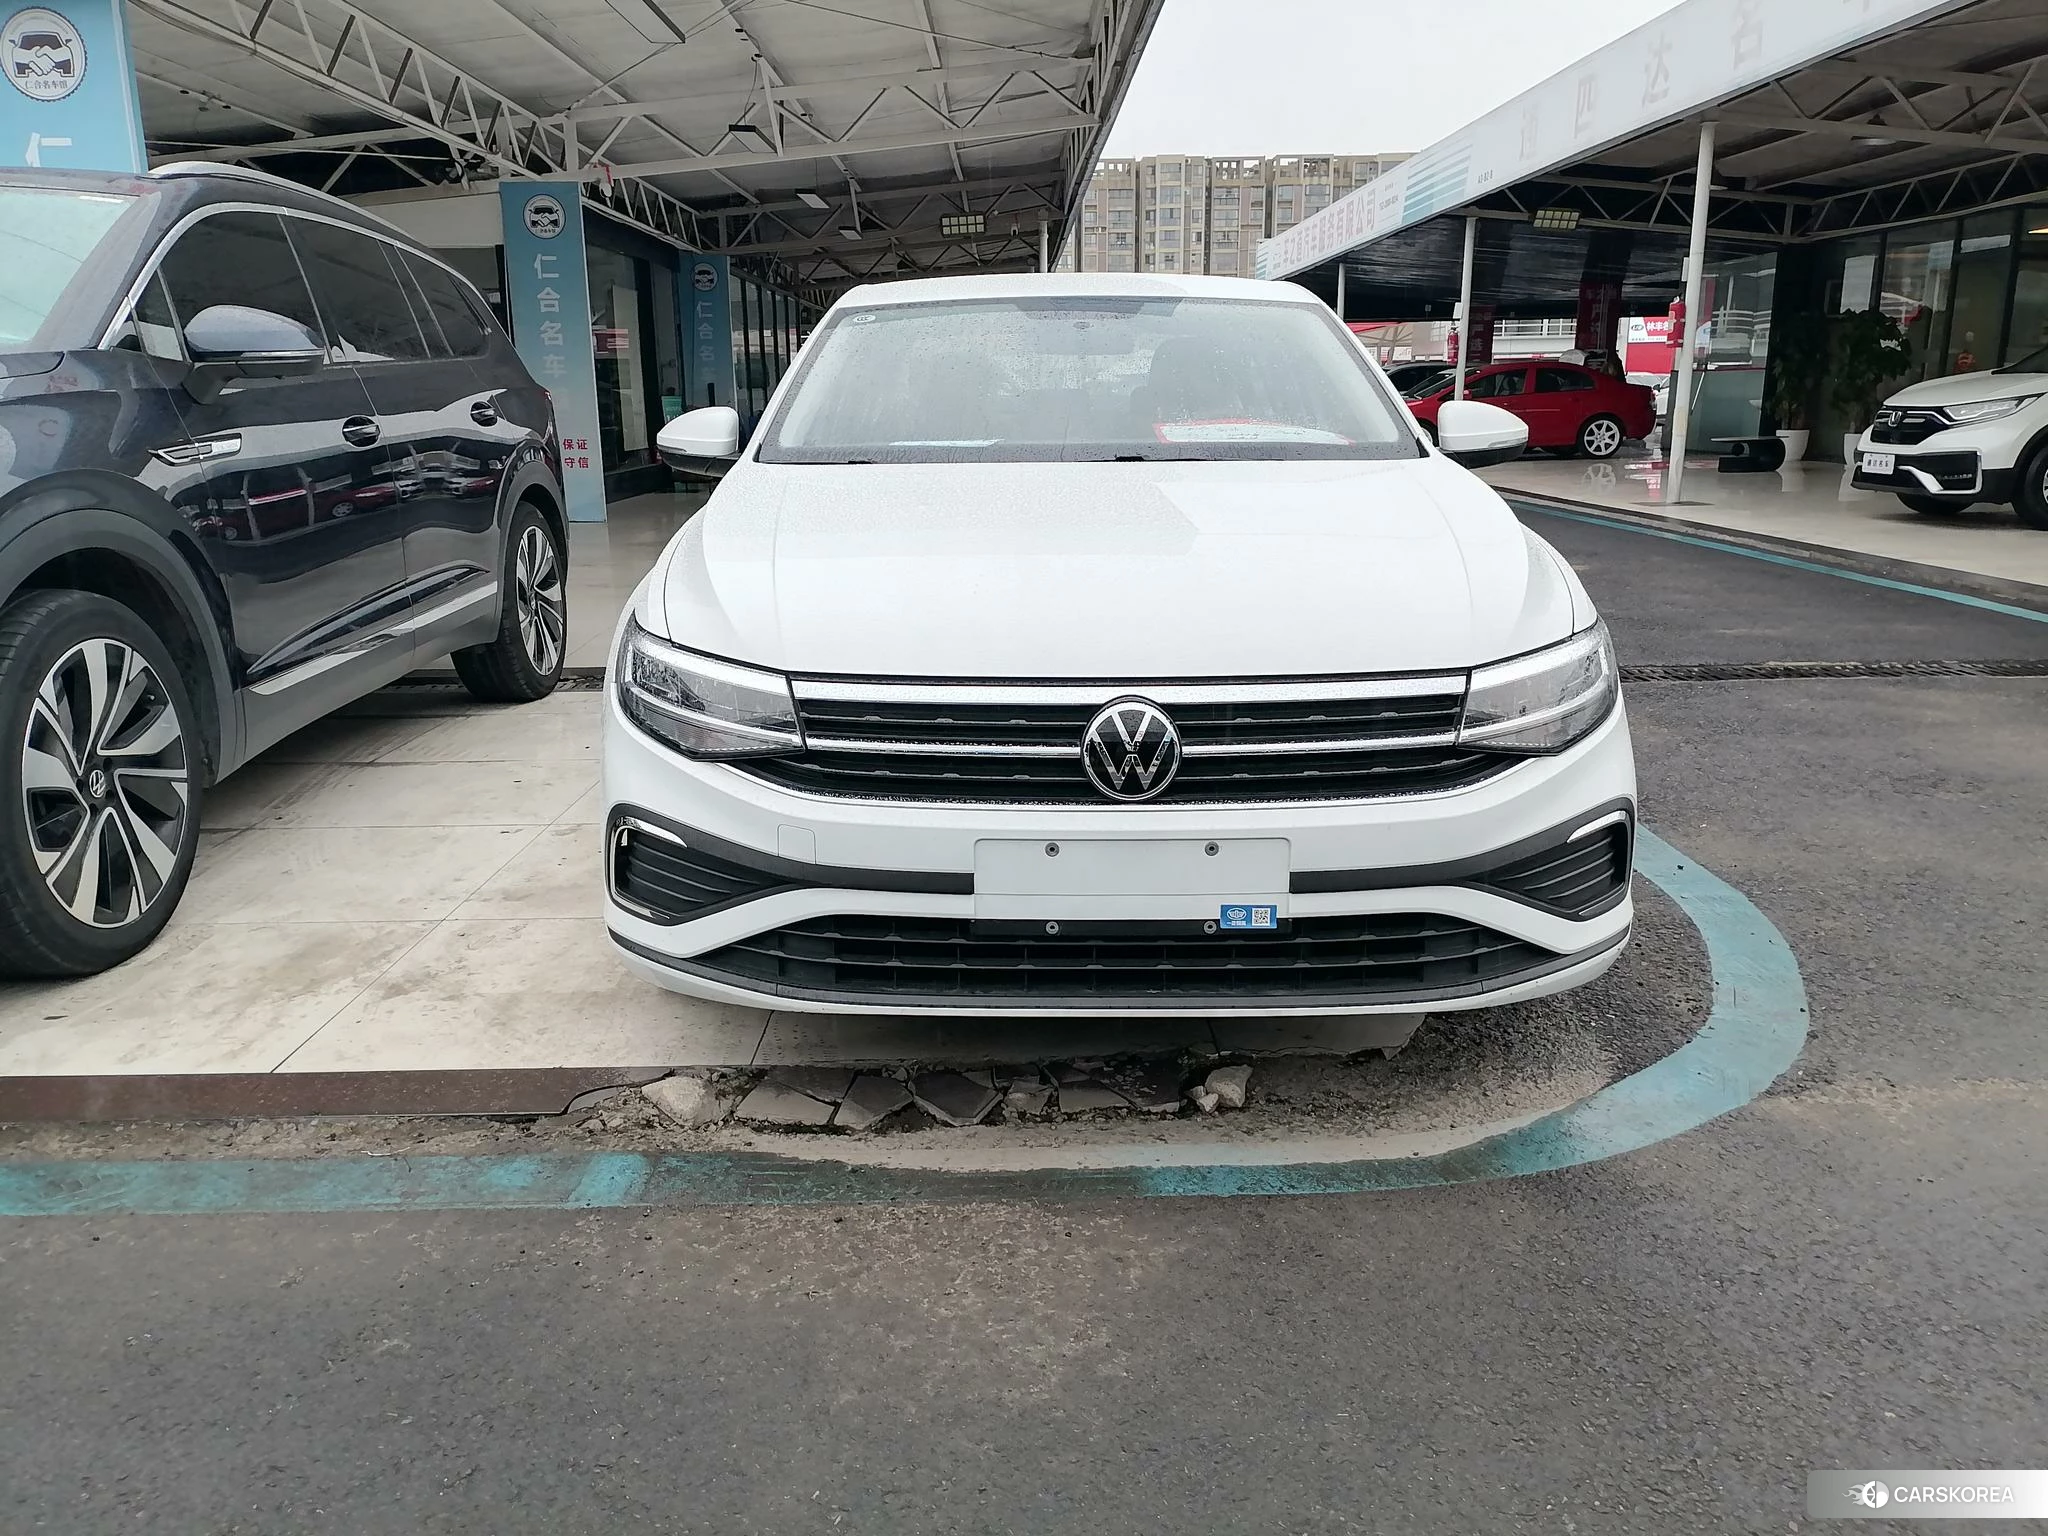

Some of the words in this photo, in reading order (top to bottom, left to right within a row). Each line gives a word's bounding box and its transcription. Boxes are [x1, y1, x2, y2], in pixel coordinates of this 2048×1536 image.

[25, 79, 68, 89] 仁合名车馆
[534, 253, 571, 414] 仁合名车
[562, 439, 588, 450] 保证
[564, 457, 589, 468] 守信
